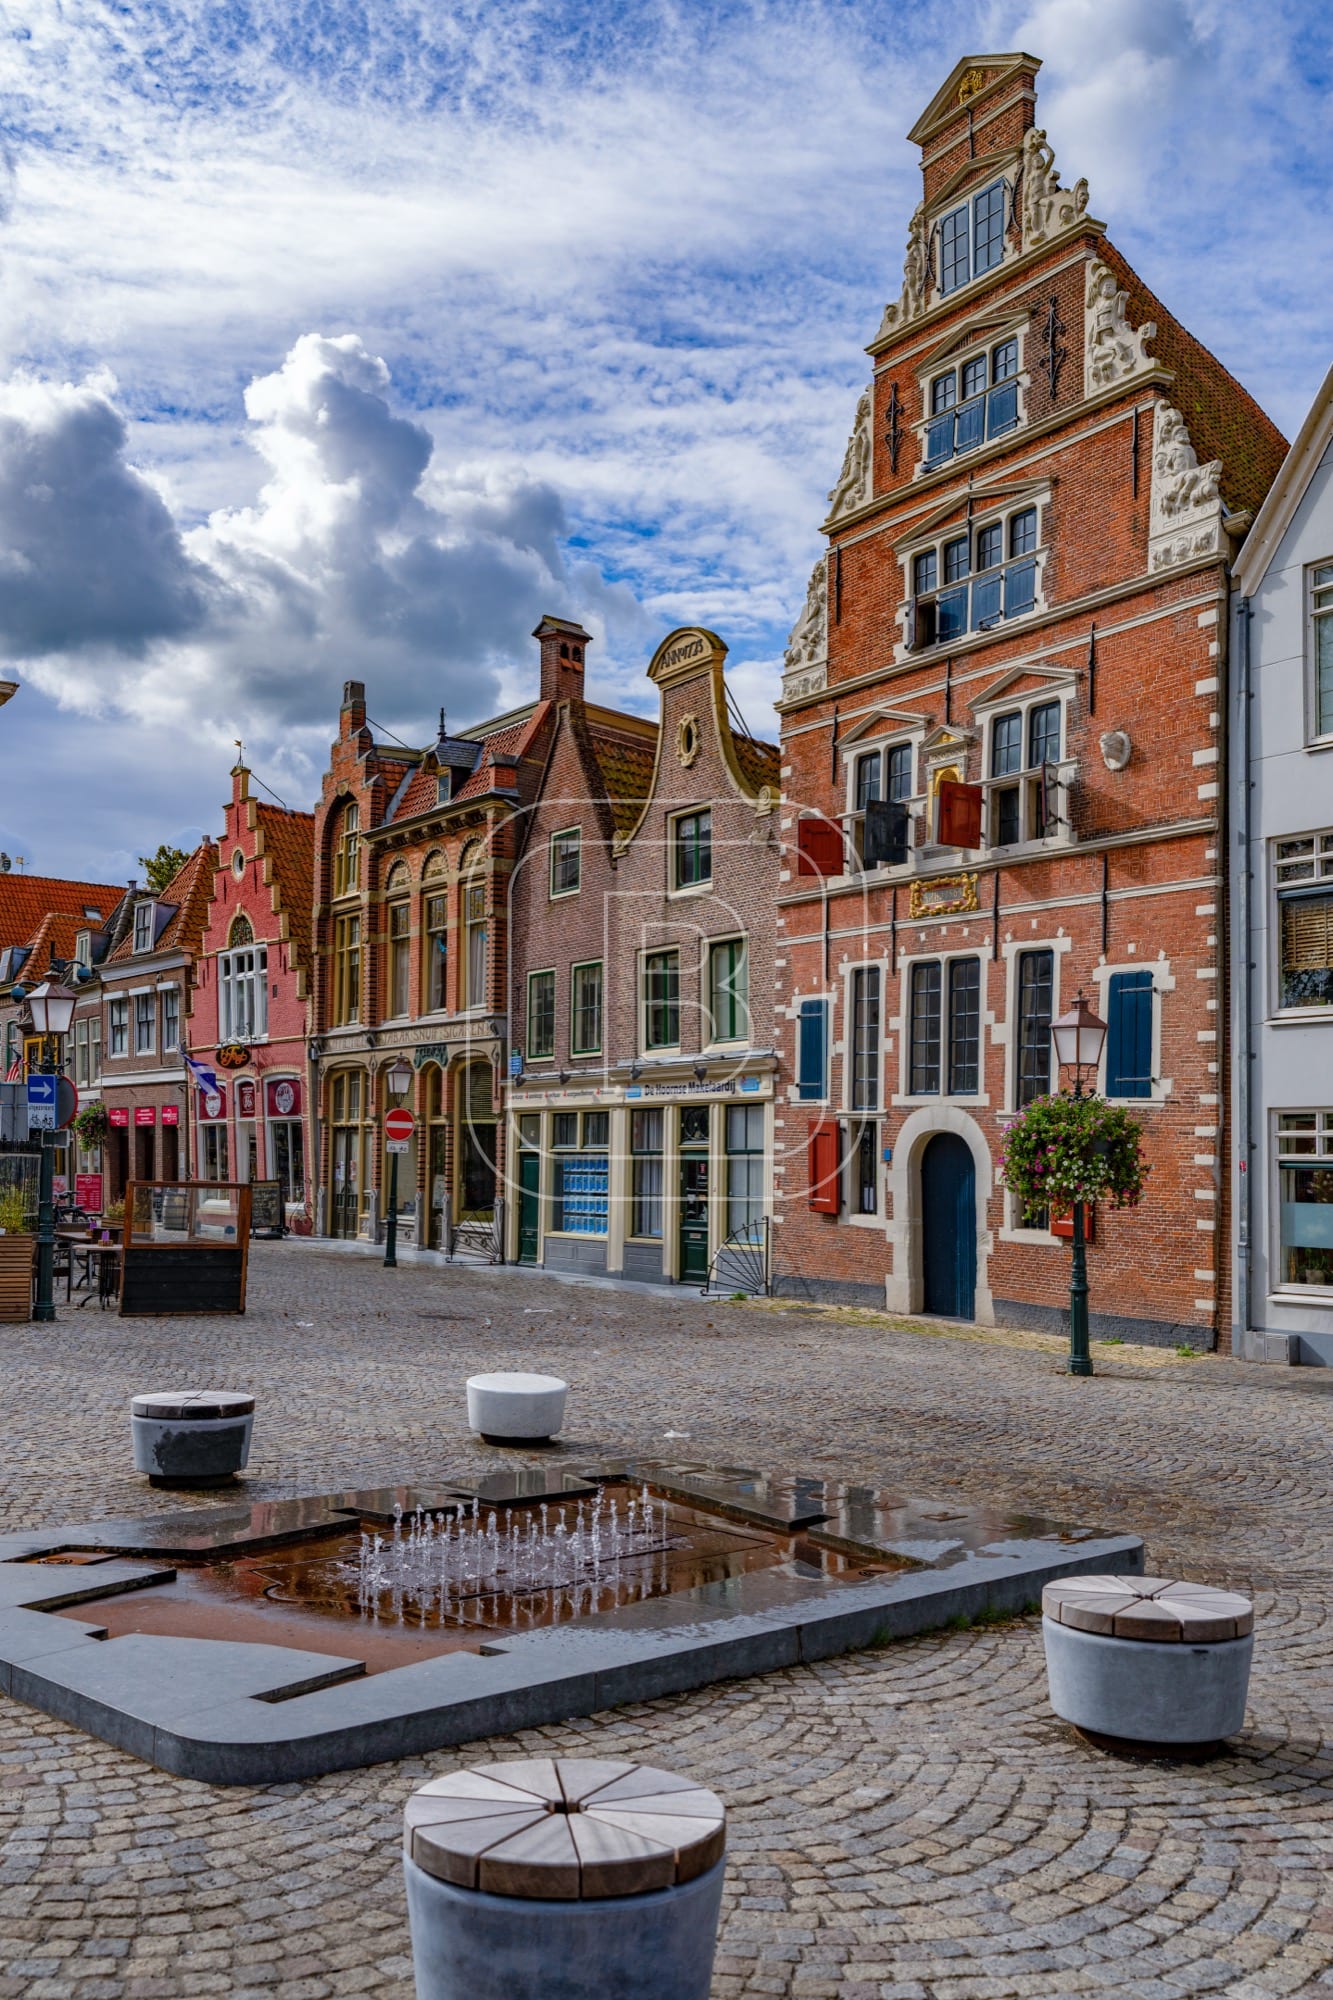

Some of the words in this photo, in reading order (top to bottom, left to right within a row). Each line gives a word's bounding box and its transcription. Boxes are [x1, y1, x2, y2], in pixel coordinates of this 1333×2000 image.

[645, 1084, 654, 1096] De
[655, 1083, 687, 1095] Hoornse
[688, 1079, 736, 1094] Makelaardij
